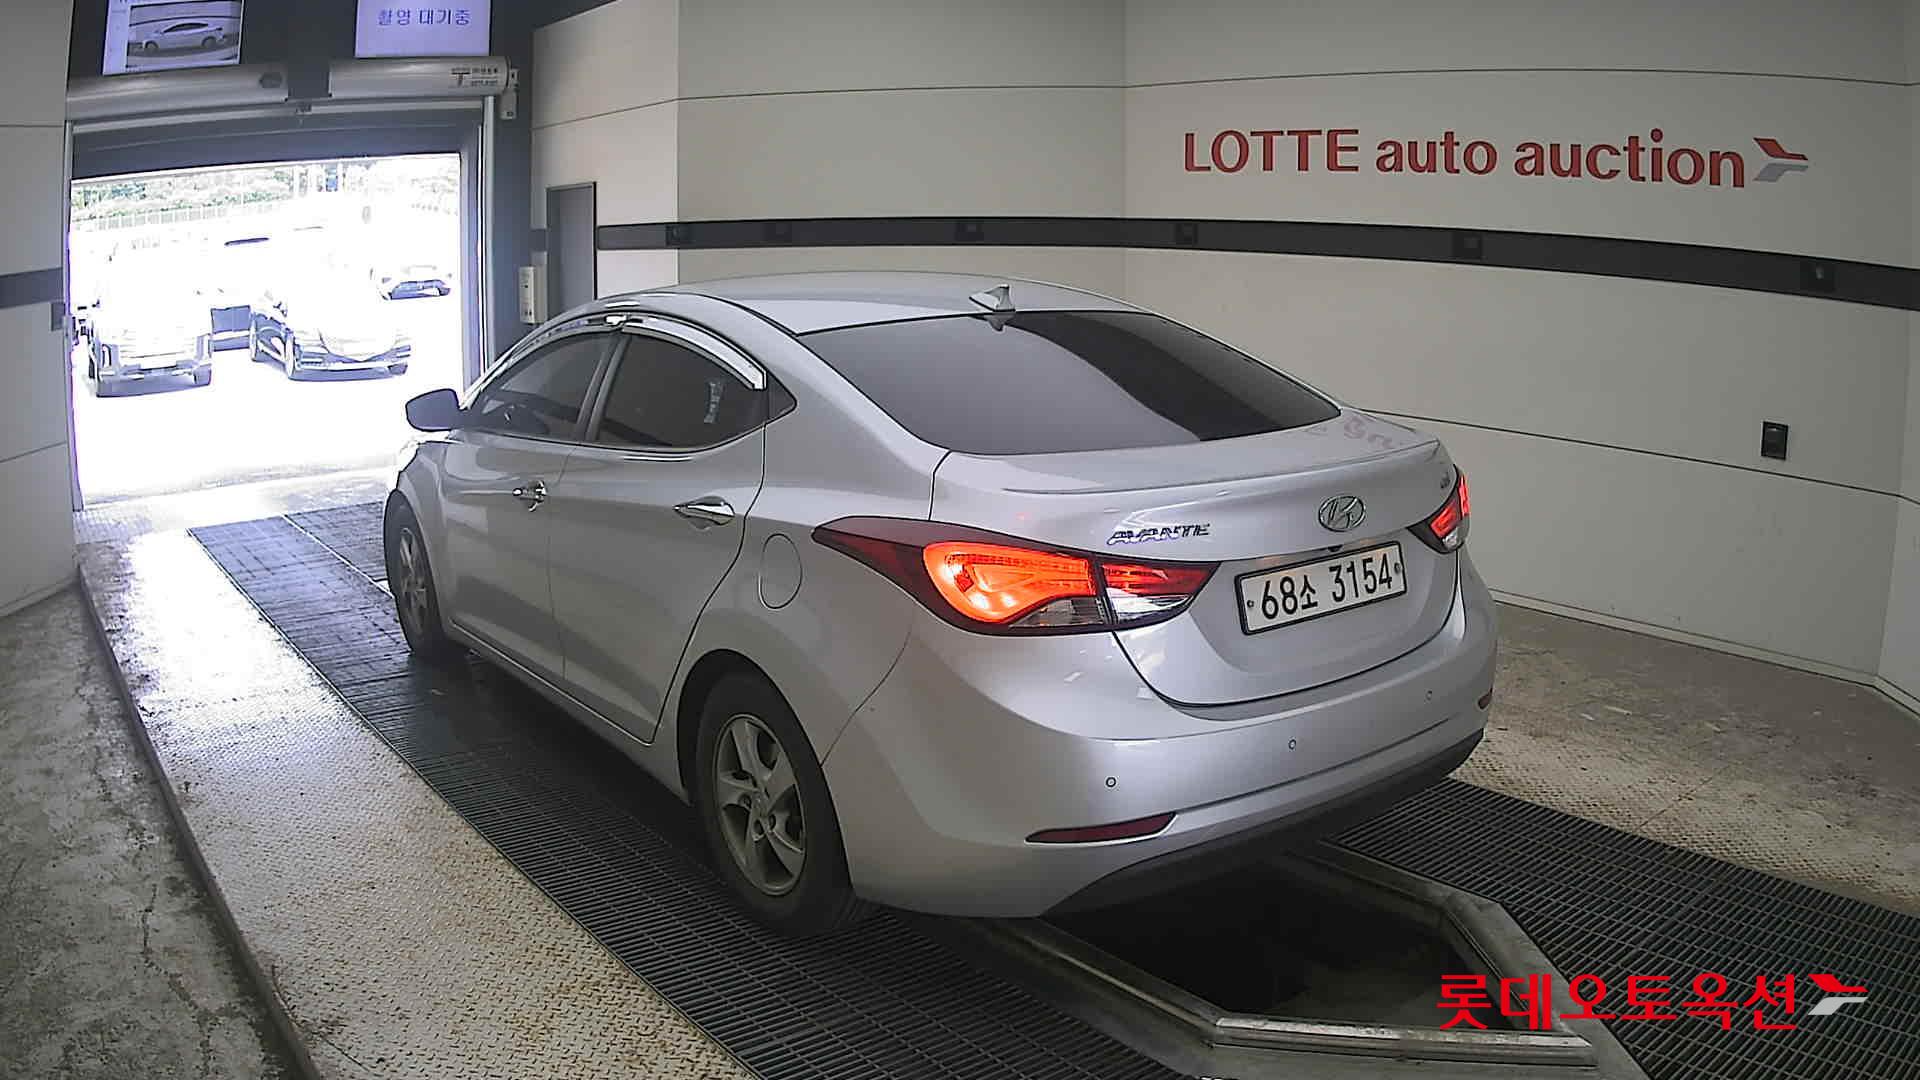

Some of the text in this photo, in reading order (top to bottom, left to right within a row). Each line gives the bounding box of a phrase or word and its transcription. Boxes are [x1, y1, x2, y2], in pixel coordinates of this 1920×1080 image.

[419, 8, 471, 26] 대기중
[1184, 129, 1745, 188] LOTTE auto auction
[1106, 523, 1211, 546] AVANTE
[1260, 553, 1393, 620] 68소 3154
